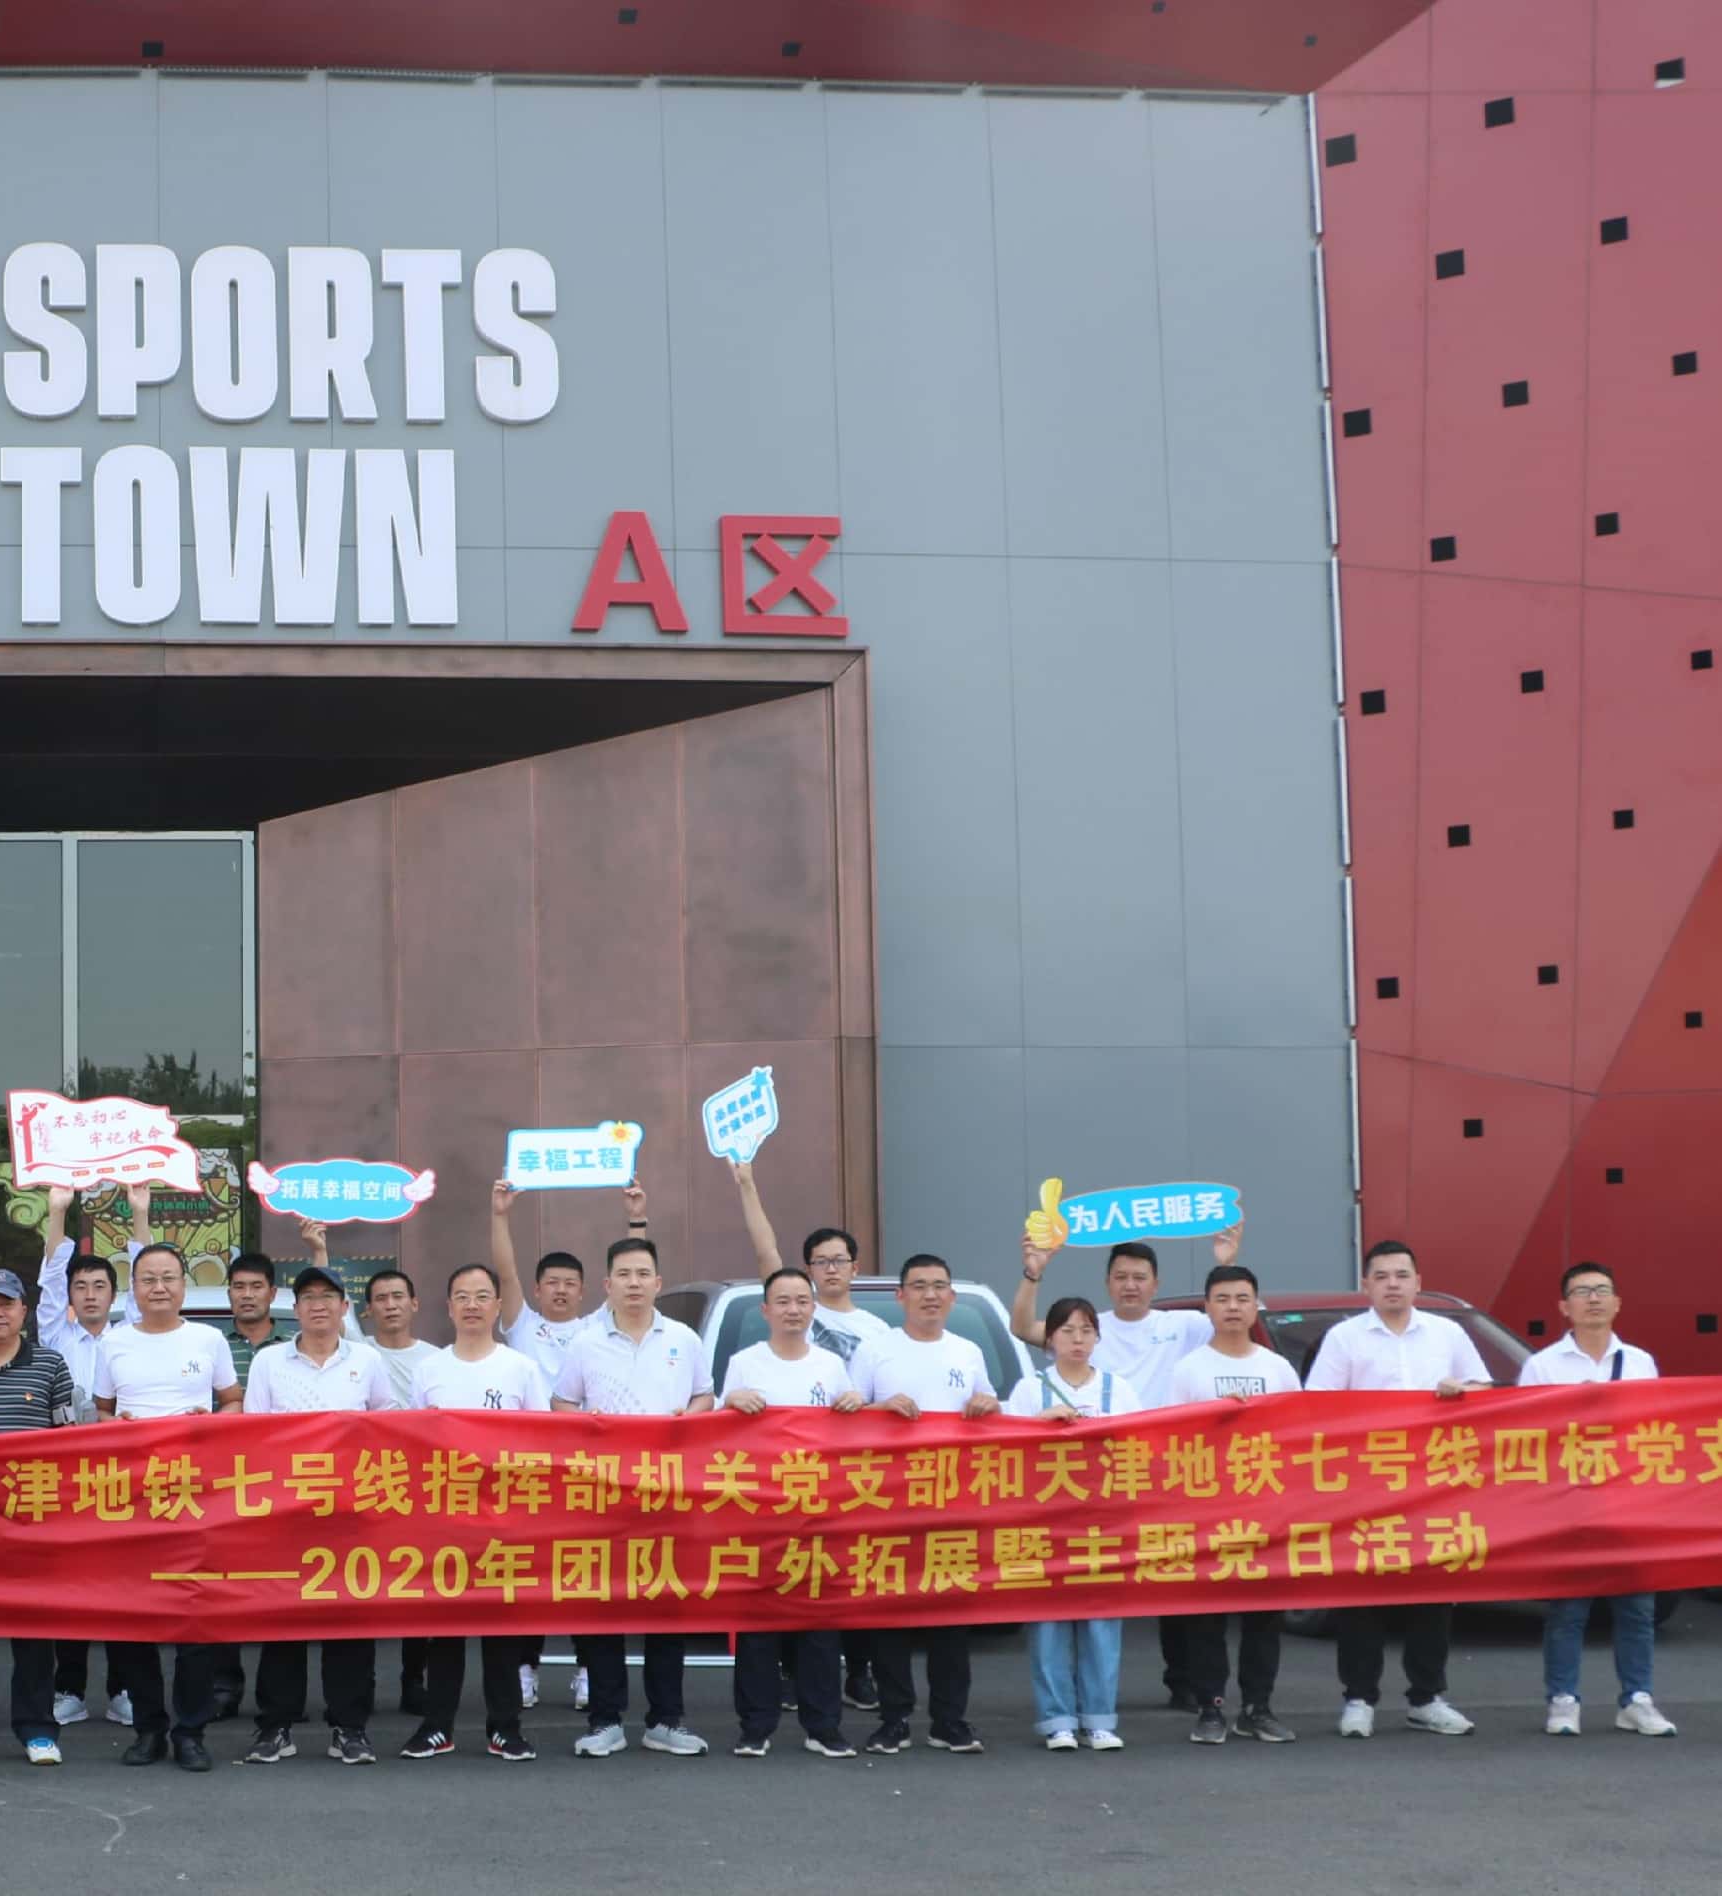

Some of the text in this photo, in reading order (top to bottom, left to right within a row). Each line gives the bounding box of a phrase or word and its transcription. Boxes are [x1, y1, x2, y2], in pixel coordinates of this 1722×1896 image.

[3, 241, 560, 425] SPORTS
[0, 444, 459, 625] TOWN
[54, 1109, 127, 1128] 不忘初心
[89, 1125, 164, 1150] 牢记使命
[517, 1146, 624, 1173] 幸福工程
[280, 1178, 402, 1204] 拓展幸福空间
[1067, 1192, 1227, 1233] 为人民服务
